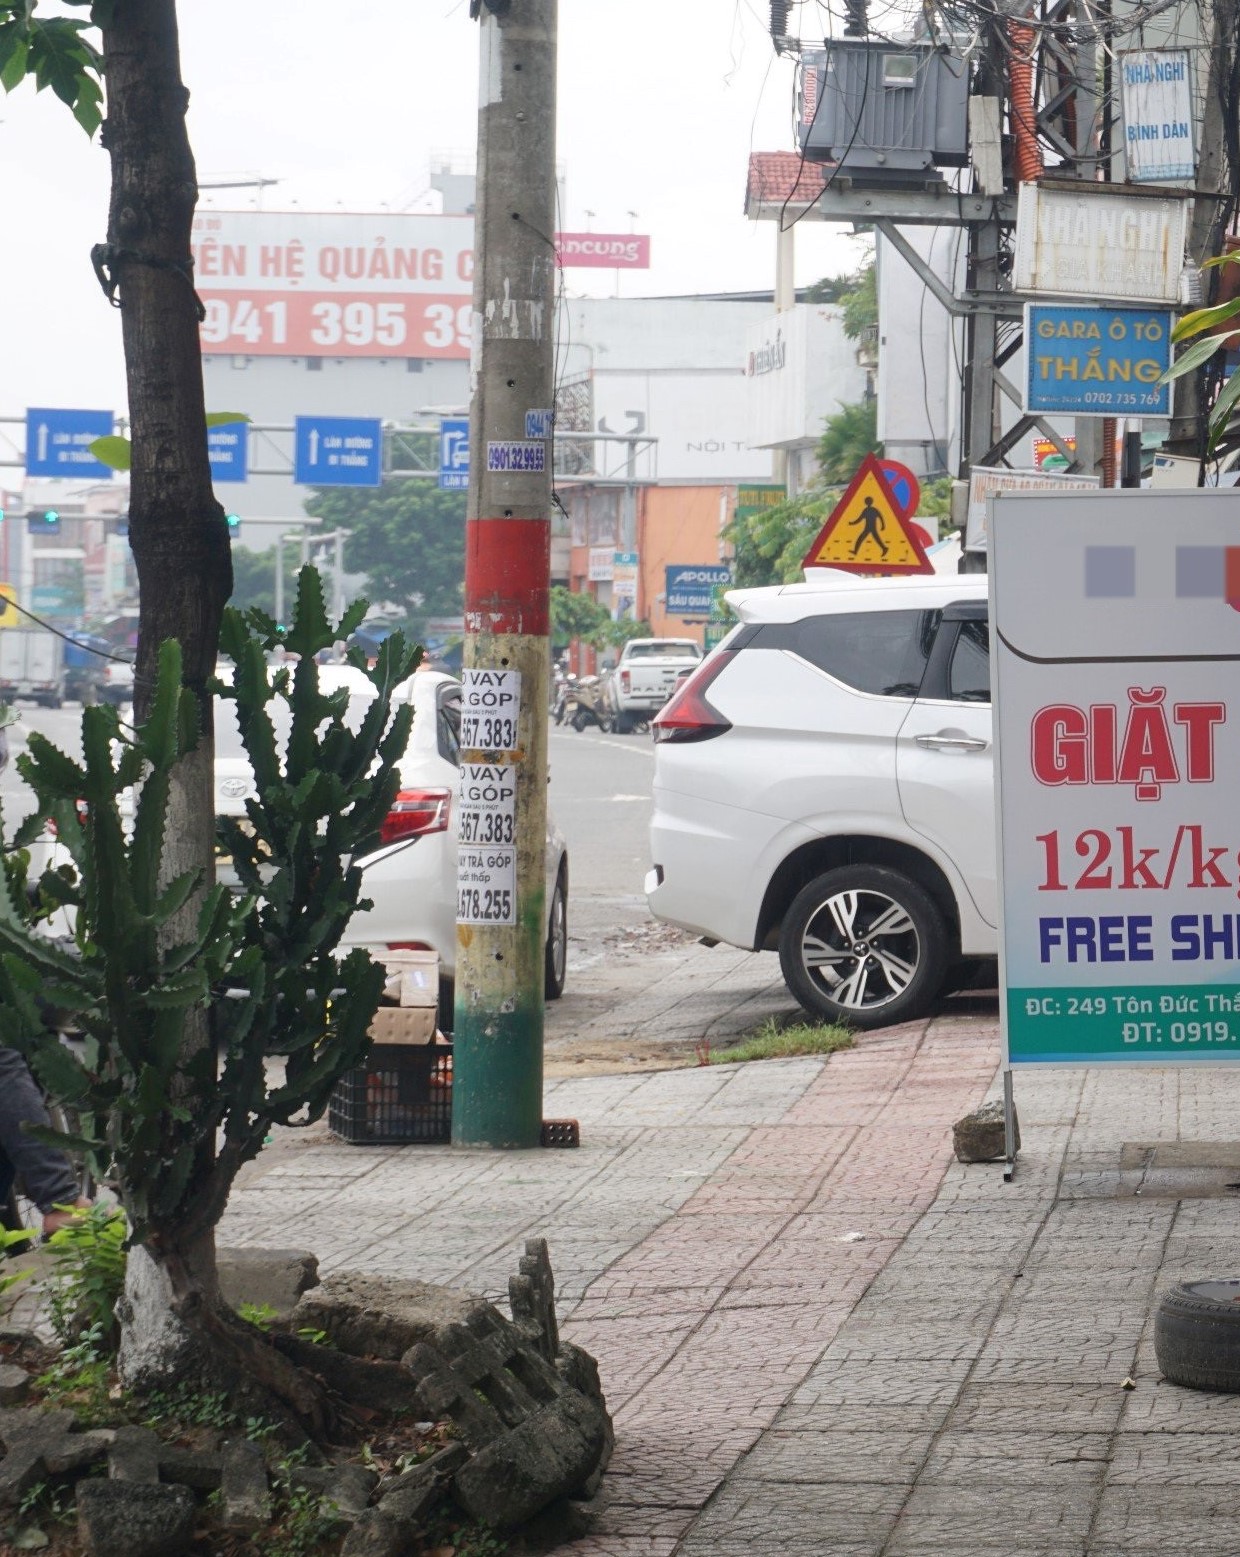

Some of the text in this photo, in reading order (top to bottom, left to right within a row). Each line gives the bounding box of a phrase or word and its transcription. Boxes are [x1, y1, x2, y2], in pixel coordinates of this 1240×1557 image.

[1127, 122, 1159, 141] BÌNH
[260, 239, 305, 286] HỆ
[318, 236, 443, 283] QUẢNG
[311, 301, 407, 346] 395
[1038, 316, 1162, 341] GARA Ô TÔ
[1037, 346, 1161, 383] THẮNG
[674, 571, 729, 584] APOLLO
[470, 672, 508, 687] VAY
[469, 689, 513, 707] GÓP
[1030, 686, 1226, 802] GIẶT
[470, 766, 508, 781] VAY
[469, 784, 513, 802] GÓP
[468, 851, 484, 868] TRẢ
[487, 852, 511, 868] GÓP
[471, 870, 491, 884] thấp
[1039, 914, 1155, 964] FREE
[1025, 998, 1061, 1016] ĐC:
[1067, 997, 1107, 1016] 249
[1112, 994, 1153, 1015] Tôn
[1159, 994, 1199, 1014] Đức
[1122, 1023, 1162, 1043] ĐT:
[1170, 1022, 1237, 1042] 0919.
